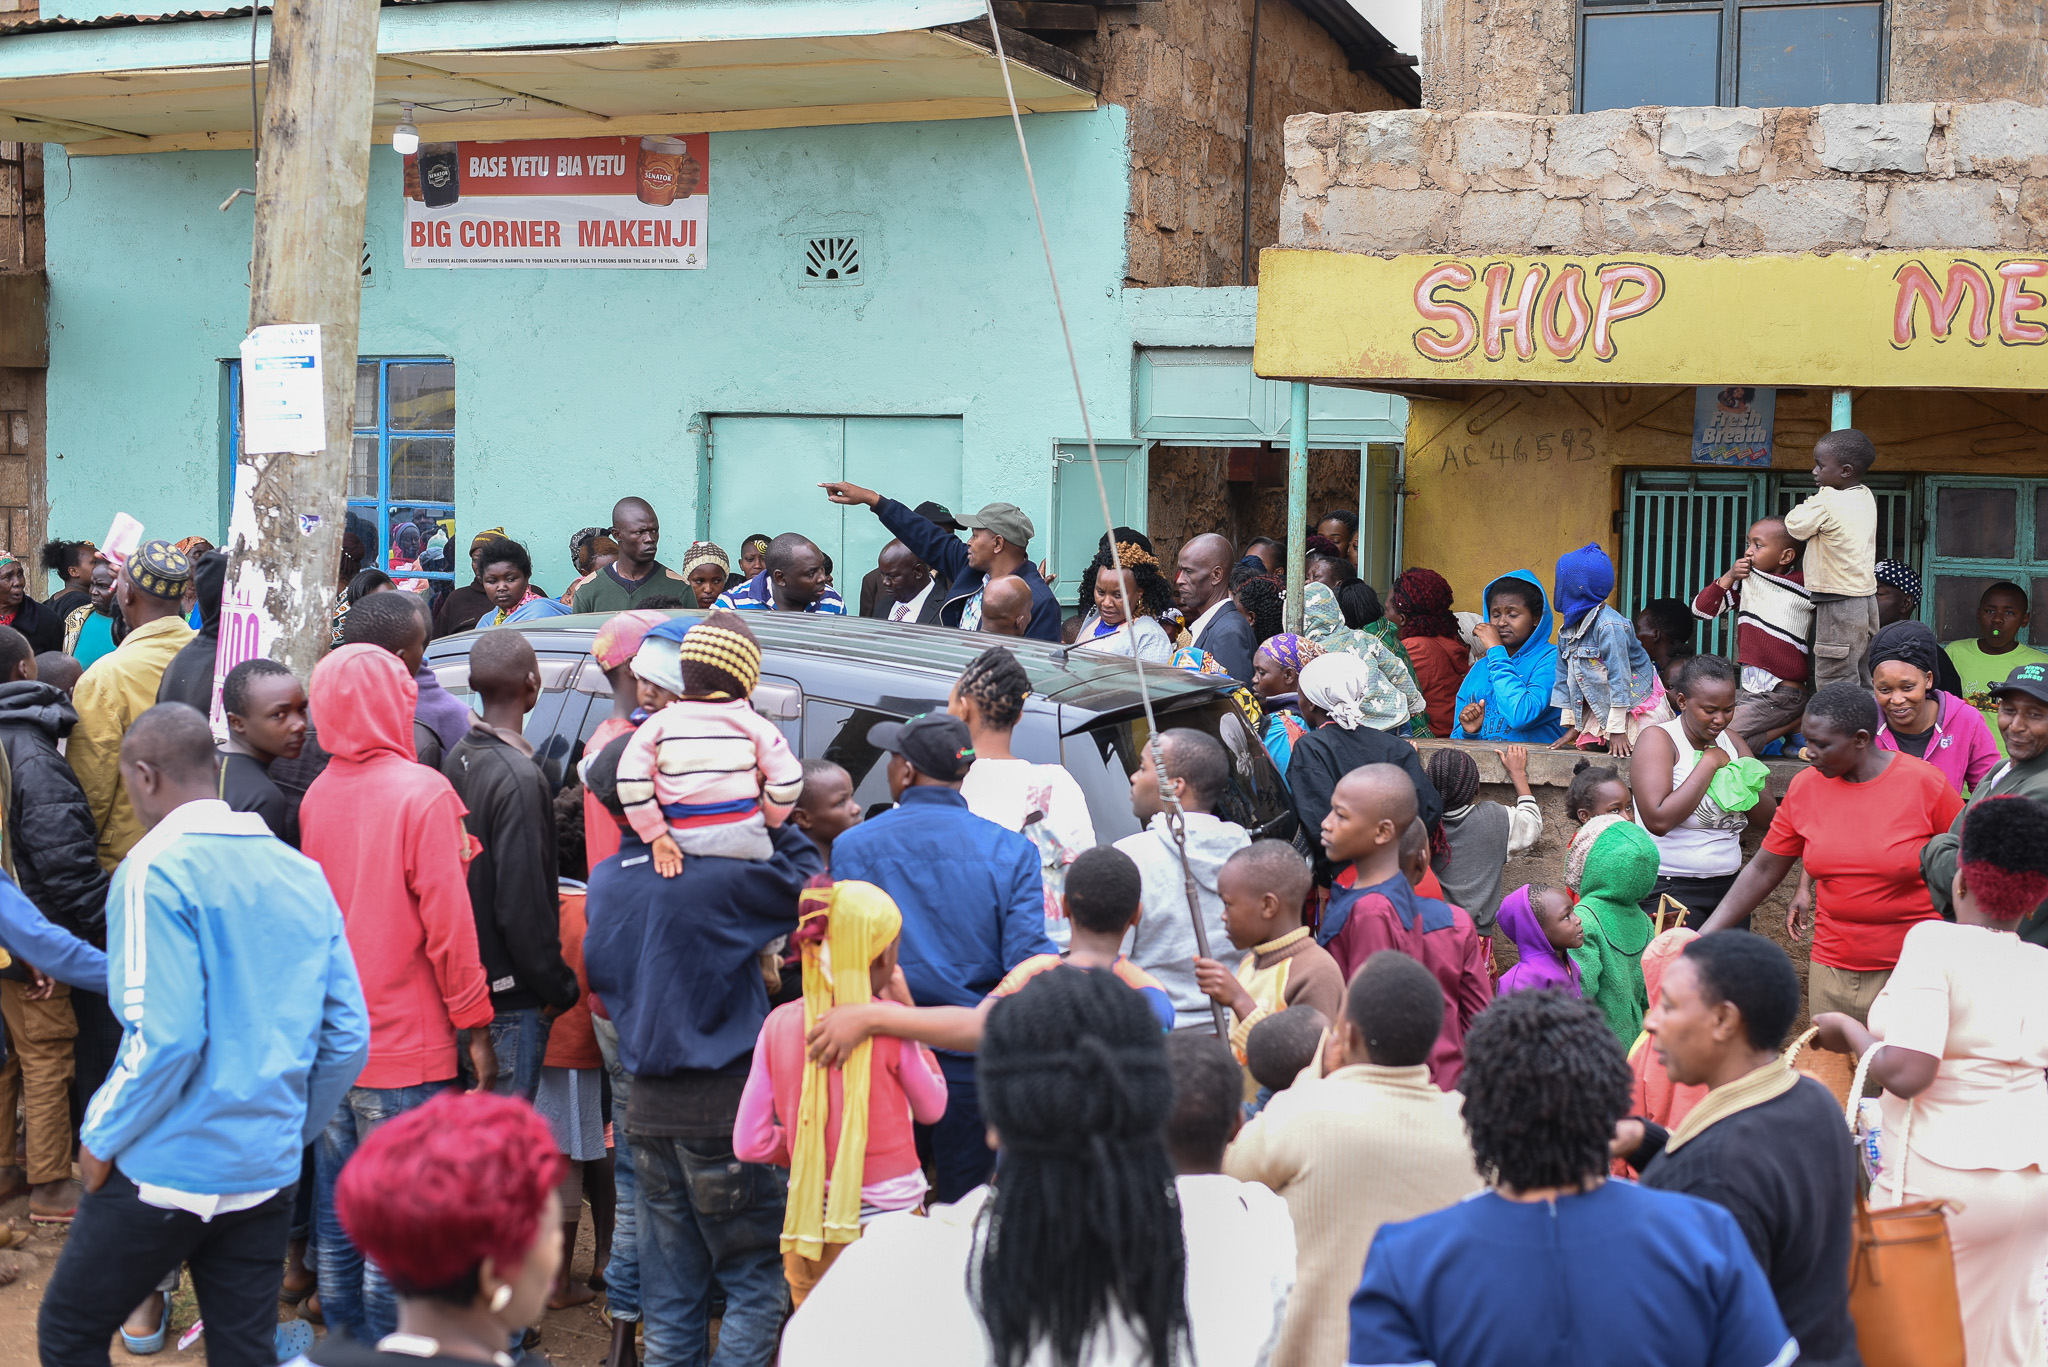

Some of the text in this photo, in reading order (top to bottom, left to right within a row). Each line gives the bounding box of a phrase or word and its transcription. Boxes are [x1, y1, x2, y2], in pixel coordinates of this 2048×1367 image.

[469, 155, 626, 177] BASE YETU BIA YETU
[645, 172, 672, 182] SENATOR
[411, 220, 697, 247] BIG CORNER MAKENJI
[1412, 260, 1666, 363] SHOP
[1710, 408, 1762, 428] Fresh
[1702, 425, 1767, 444] Breath
